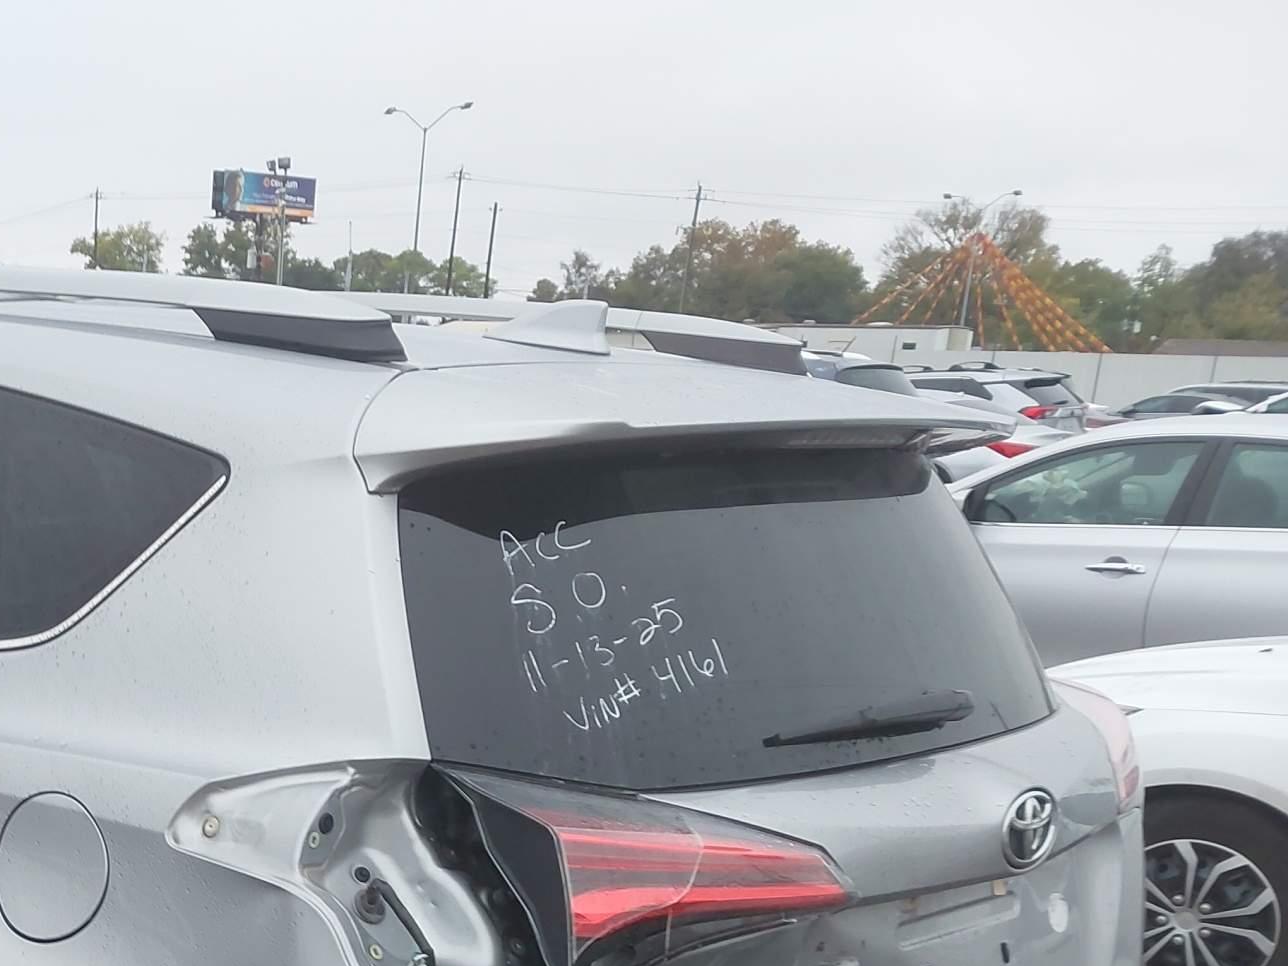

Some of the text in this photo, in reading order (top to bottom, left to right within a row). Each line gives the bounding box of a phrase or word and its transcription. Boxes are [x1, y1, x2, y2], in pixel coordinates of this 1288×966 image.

[498, 520, 592, 576] ACC
[522, 597, 684, 693] 11-13-25
[650, 638, 729, 694] 4161
